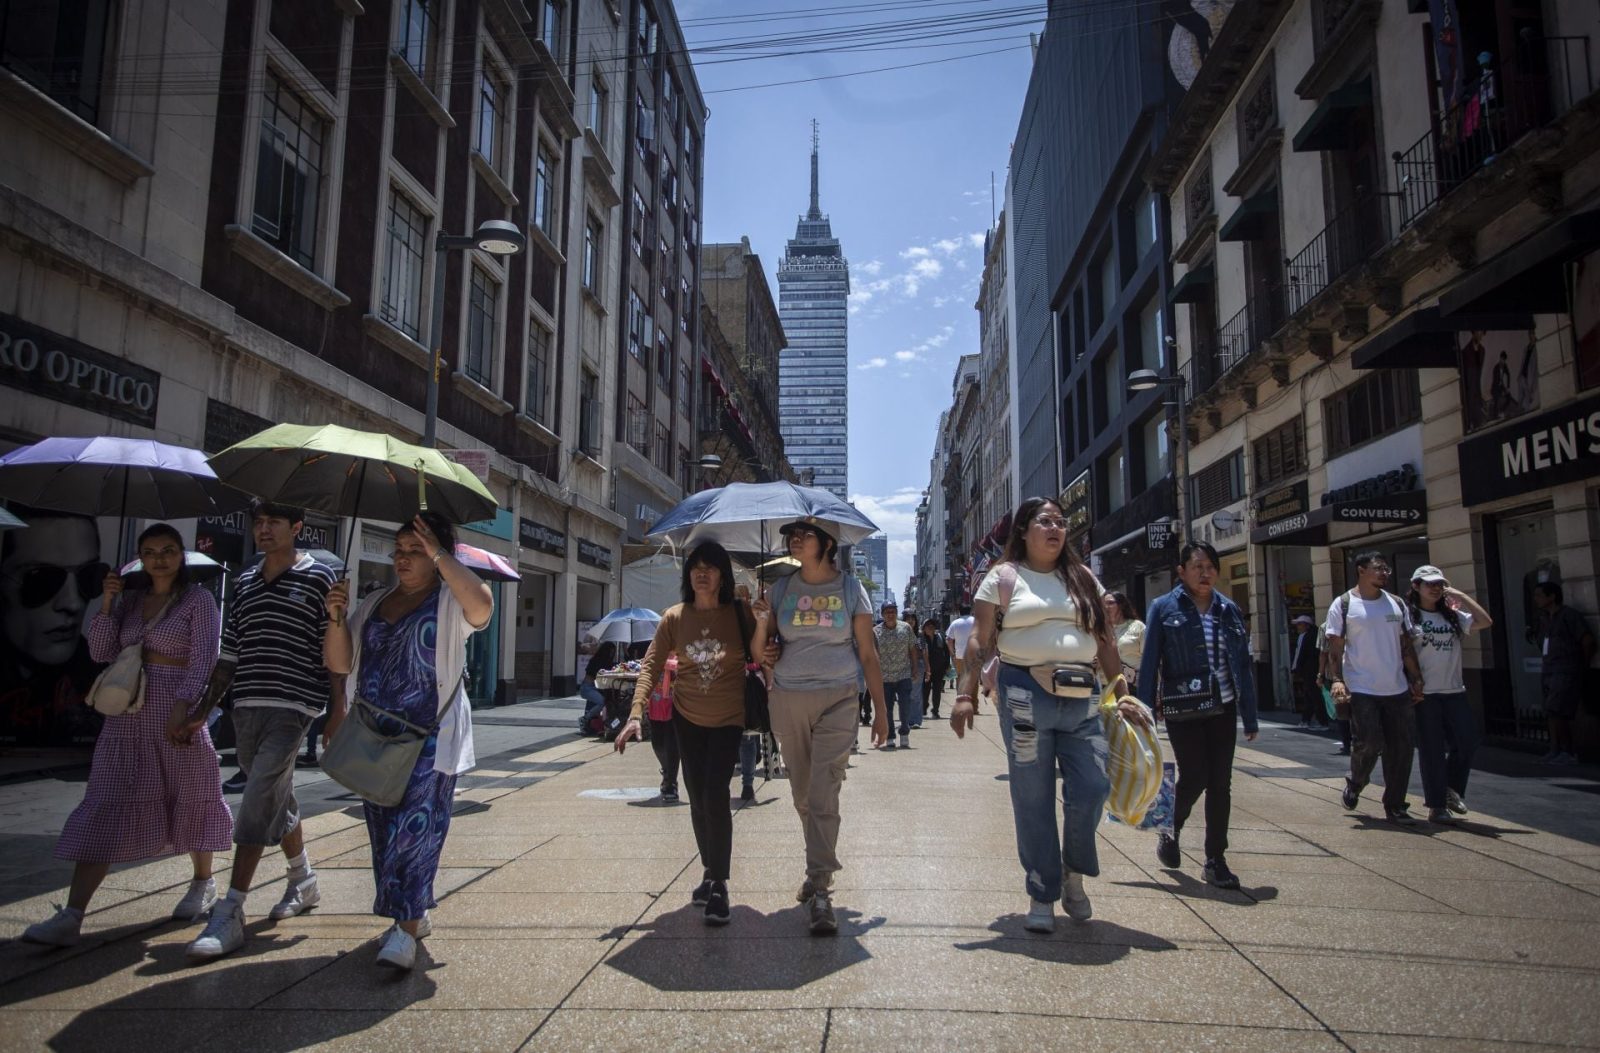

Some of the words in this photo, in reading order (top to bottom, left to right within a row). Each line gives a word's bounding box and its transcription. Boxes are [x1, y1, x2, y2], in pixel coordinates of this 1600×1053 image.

[46, 350, 154, 411] OPTICO
[1341, 508, 1408, 518] CONVERSE
[1268, 516, 1302, 536] CONVERSE
[1151, 541, 1164, 549] US
